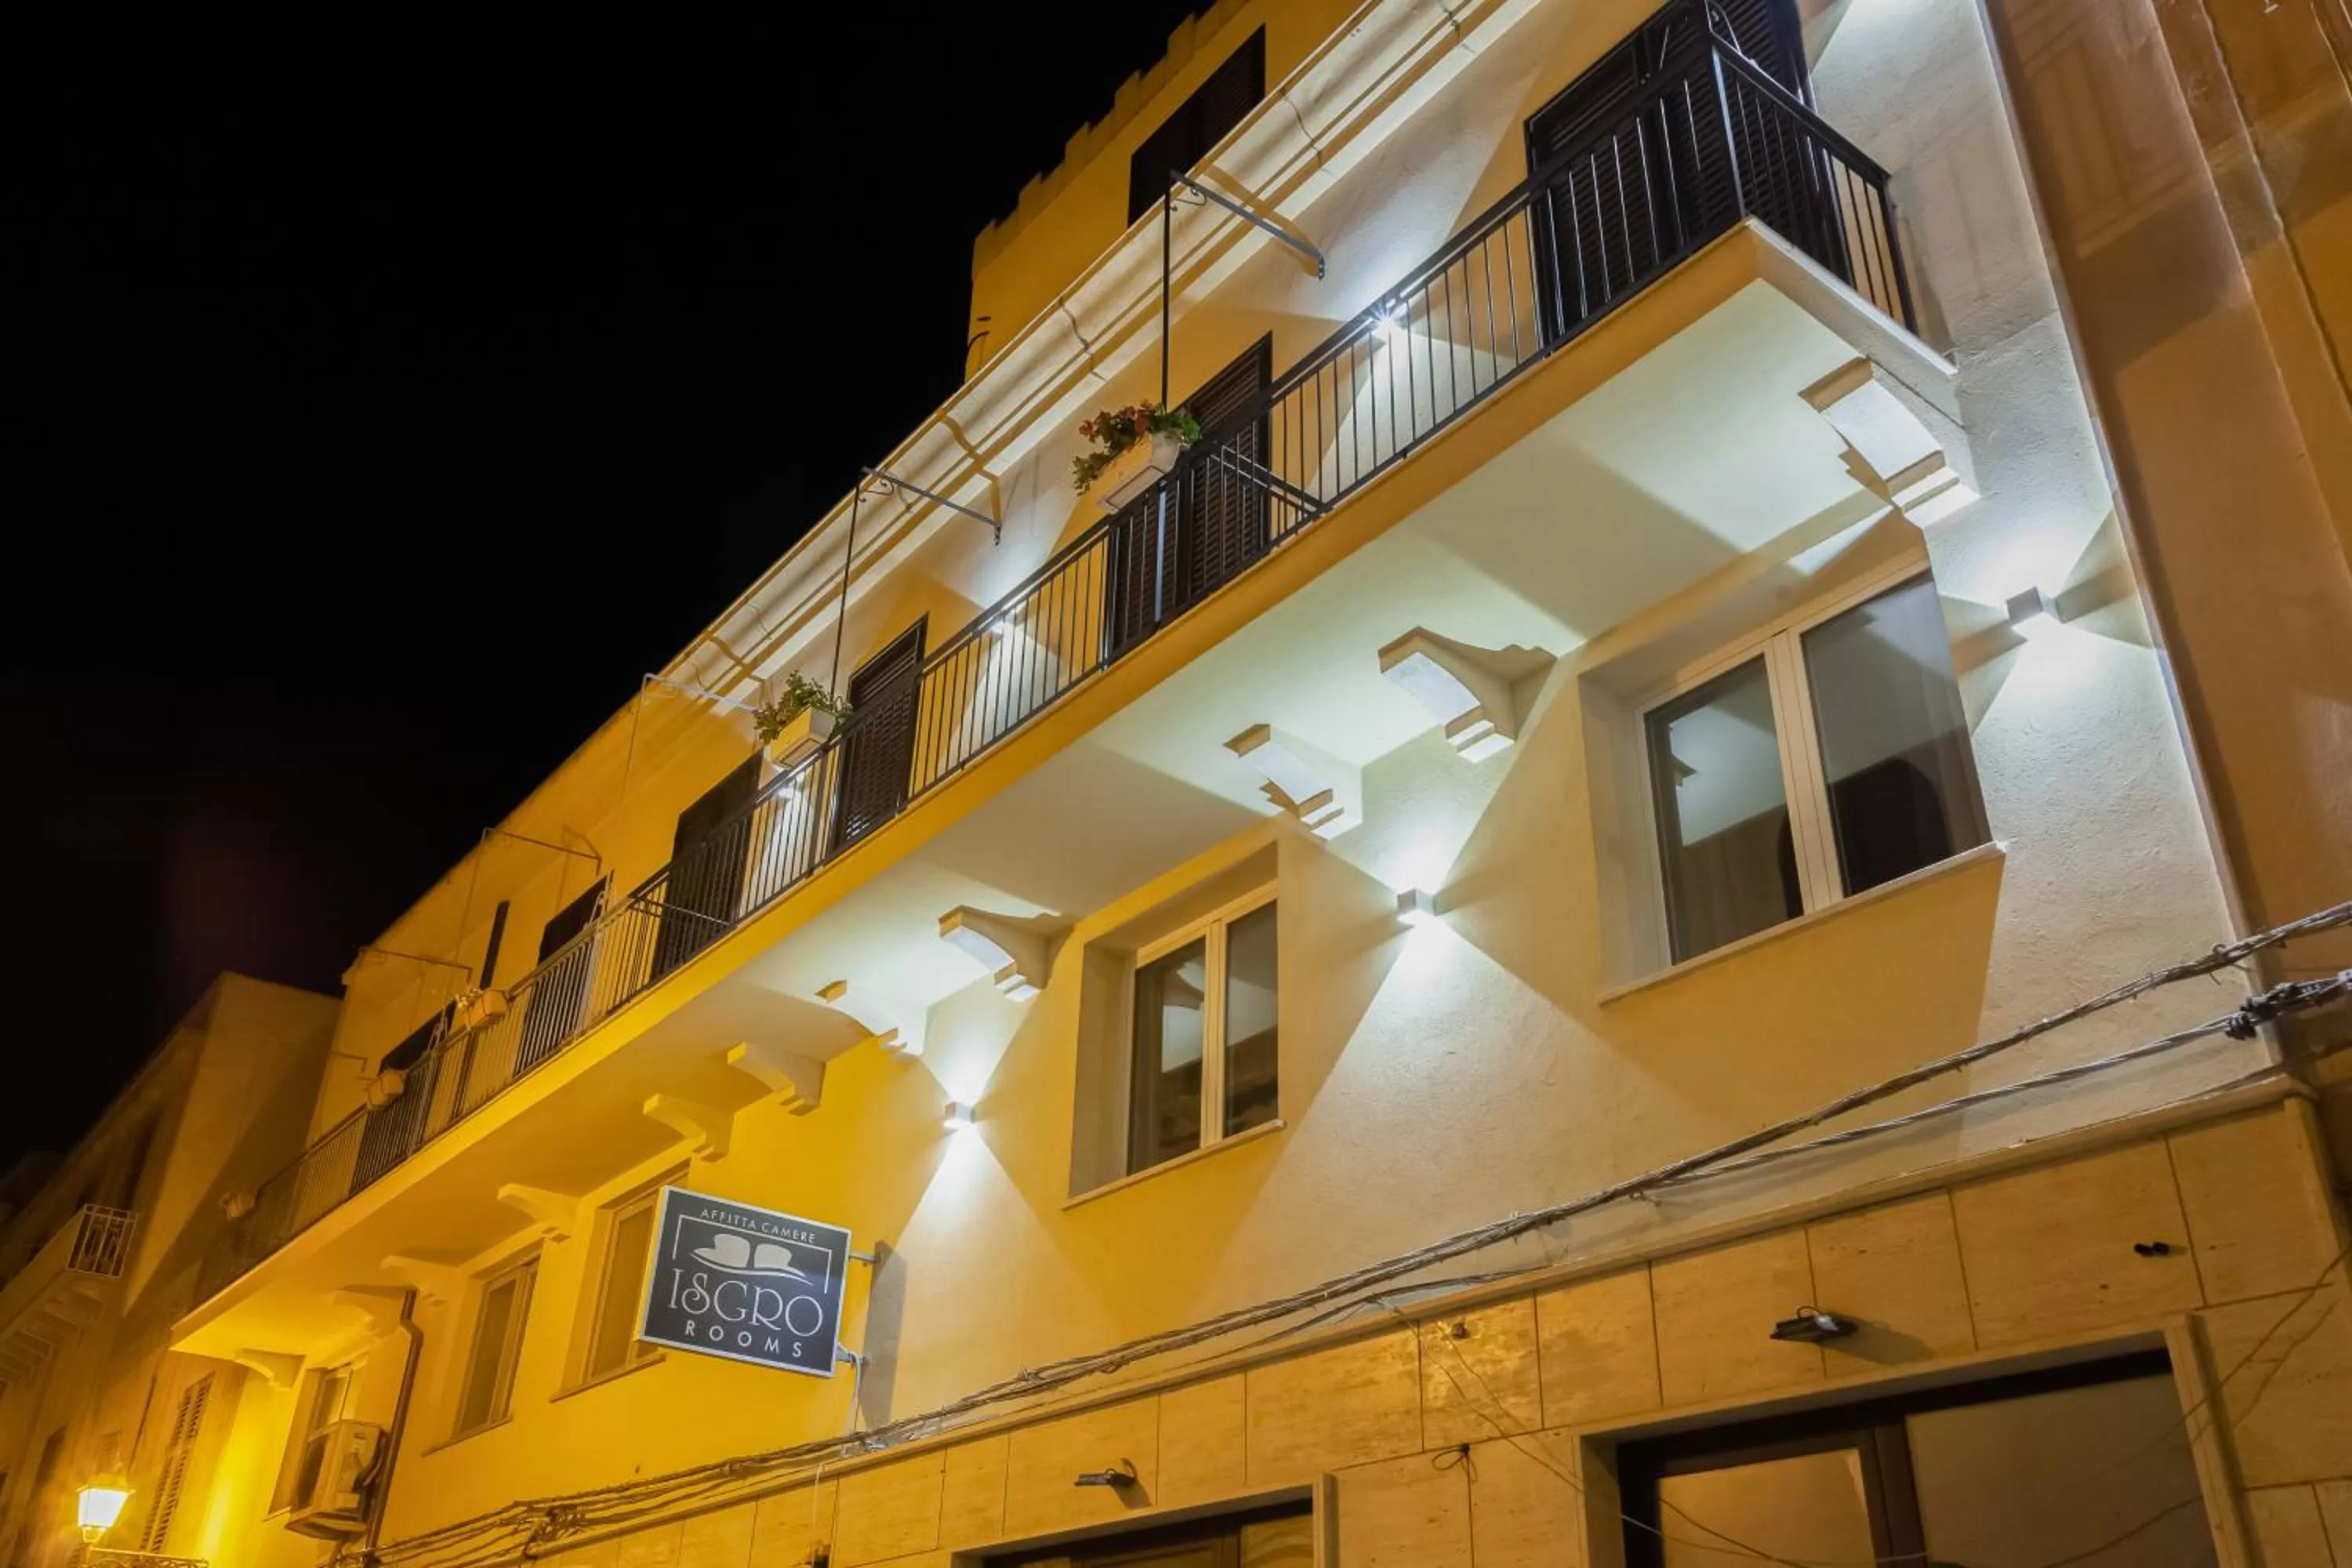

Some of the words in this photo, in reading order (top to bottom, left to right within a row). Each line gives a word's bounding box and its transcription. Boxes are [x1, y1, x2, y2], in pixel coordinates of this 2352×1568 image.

[701, 1209, 757, 1229] AFFITTA
[761, 1222, 815, 1243] CAMERE
[667, 1268, 823, 1337] ISGRO
[684, 1320, 803, 1357] ROOMS
